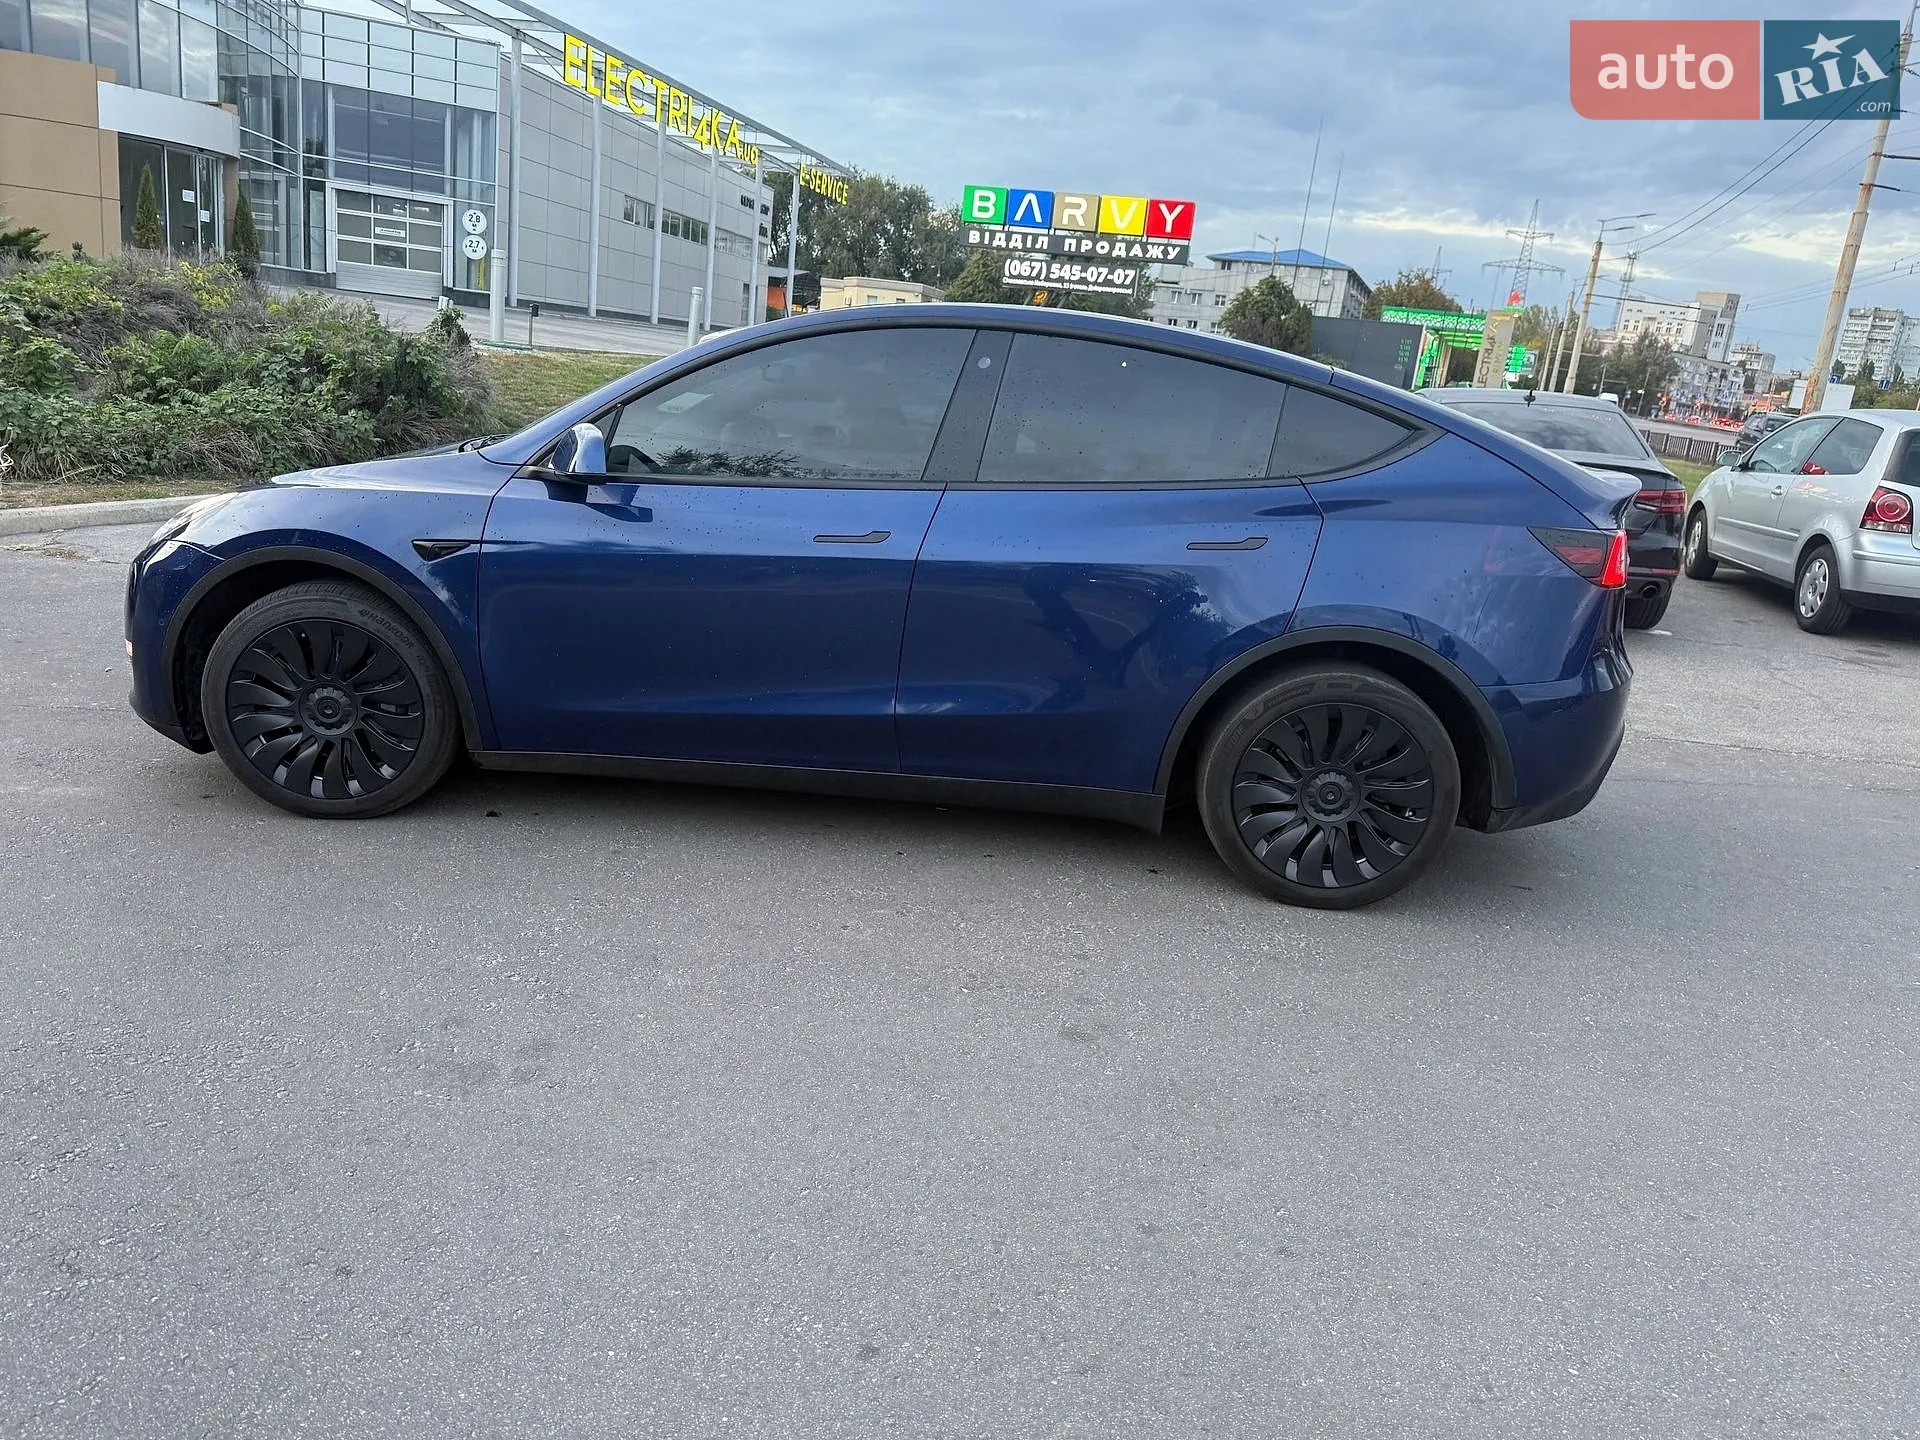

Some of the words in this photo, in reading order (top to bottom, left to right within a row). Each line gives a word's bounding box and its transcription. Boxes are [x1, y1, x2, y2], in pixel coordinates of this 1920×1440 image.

[799, 162, 849, 206] E-SERVICE
[971, 189, 1185, 233] BARVY
[967, 230, 1050, 250] ВІДДІЛ
[1063, 237, 1182, 260] ПРОДАЖУ
[1003, 258, 1047, 280] (067)
[1049, 263, 1136, 285] 545-07-07
